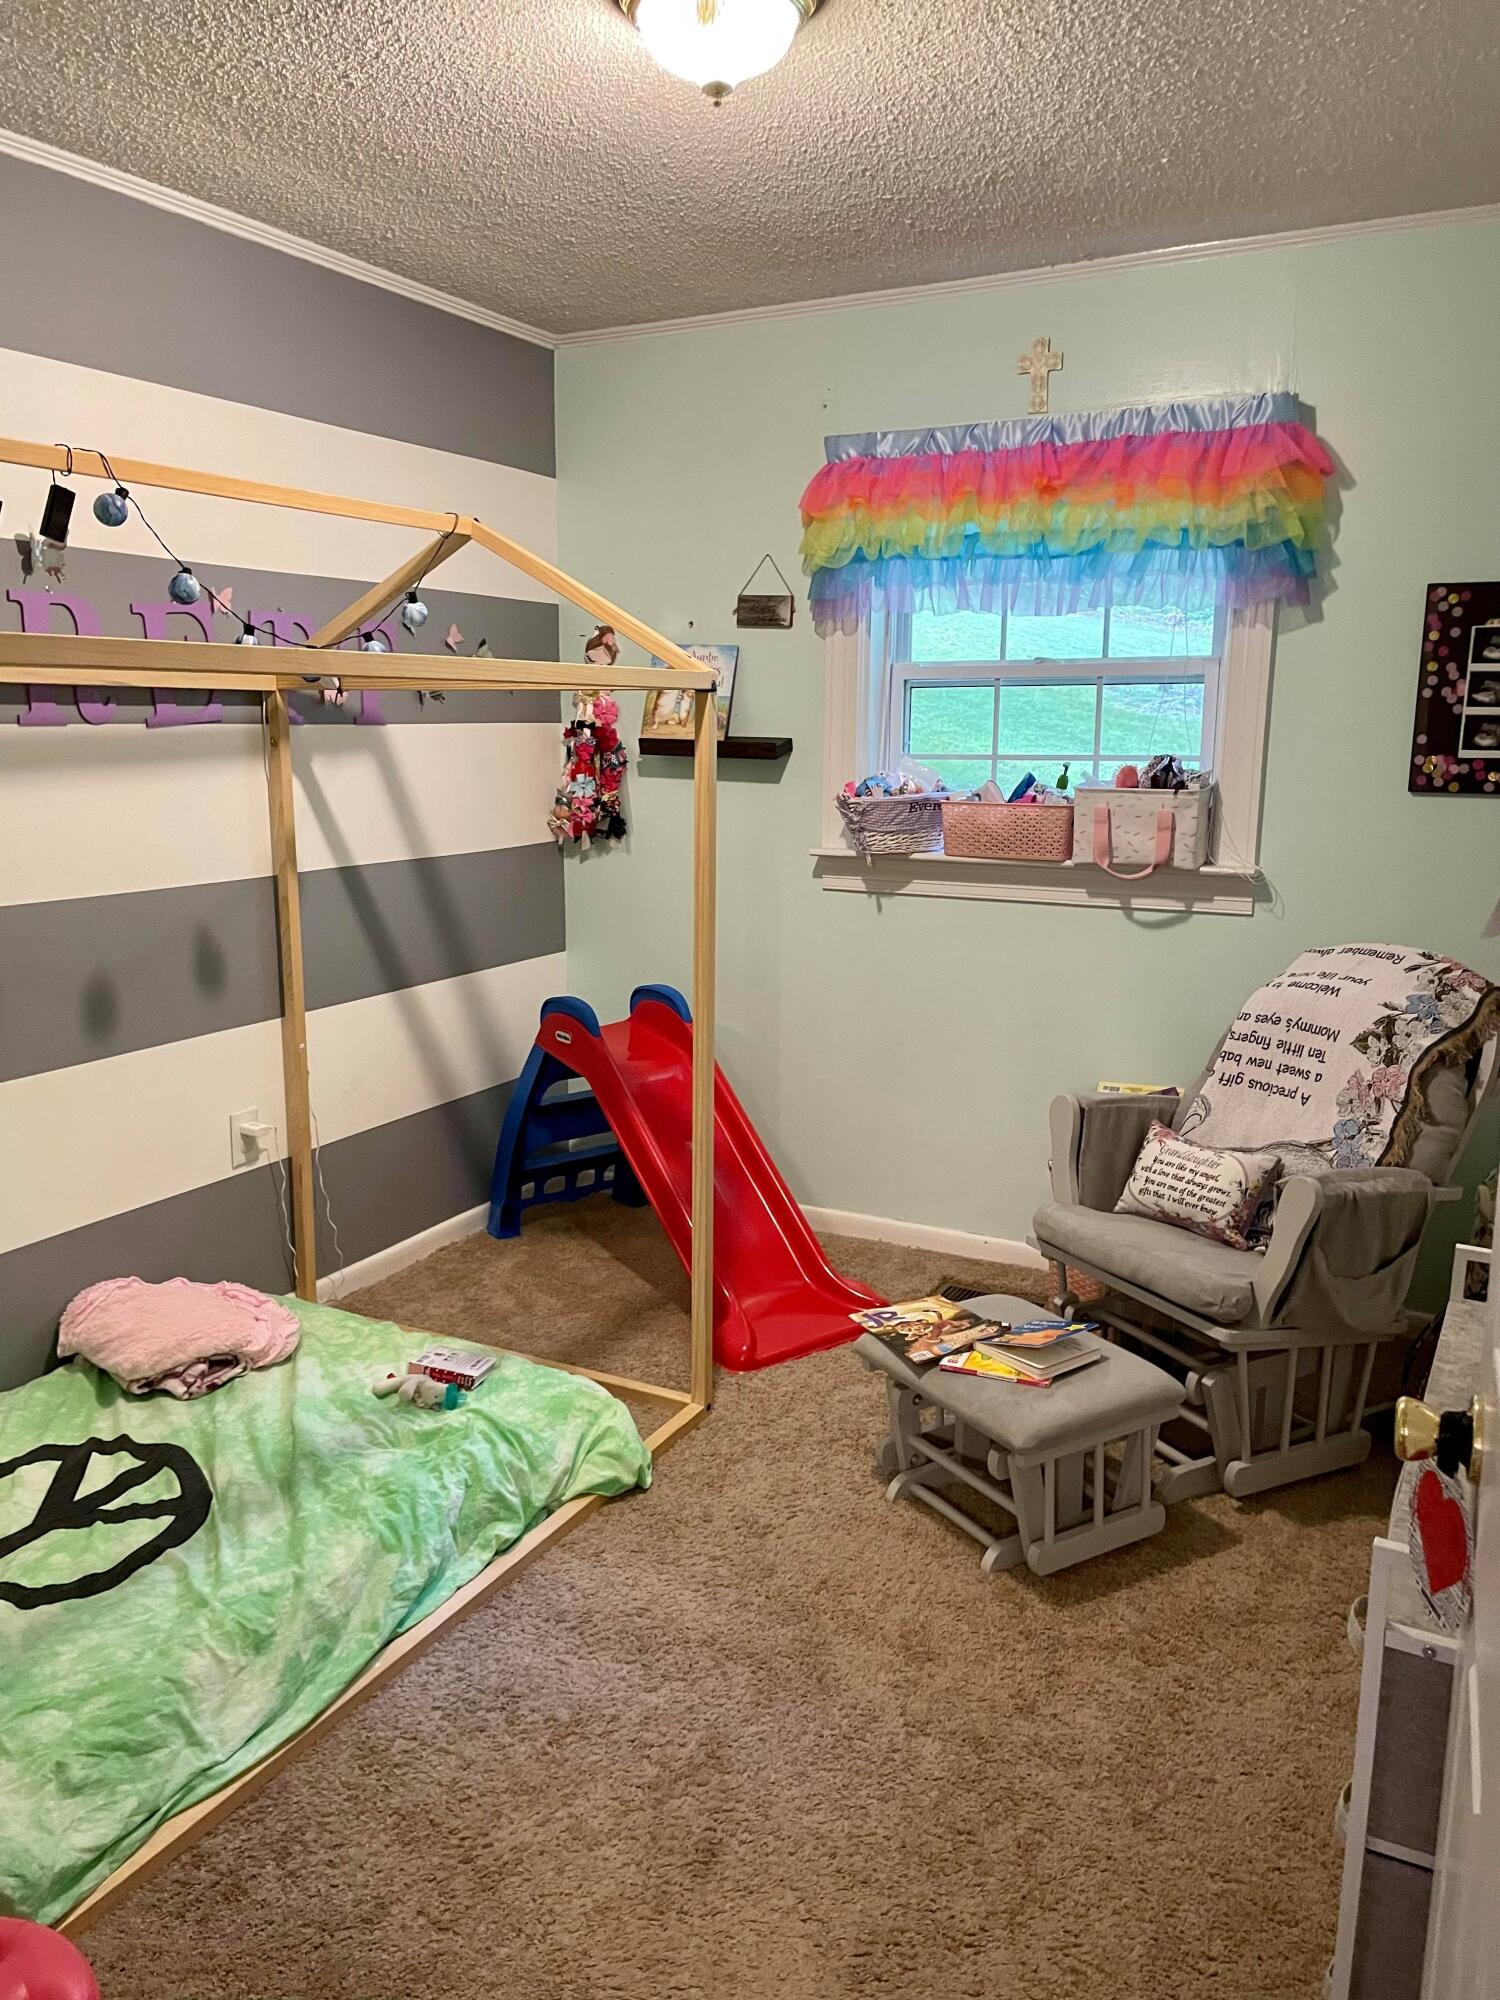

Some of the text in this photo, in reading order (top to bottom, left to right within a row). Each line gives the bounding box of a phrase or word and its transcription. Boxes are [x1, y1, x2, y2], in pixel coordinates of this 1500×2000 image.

[1337, 947, 1406, 965] Remember
[1317, 971, 1339, 980] life
[1338, 975, 1372, 986] your
[1288, 981, 1342, 997] Welcome
[1254, 1012, 1281, 1026] eyes
[1286, 1017, 1340, 1043] Mommy's
[1228, 1030, 1326, 1063] Ten little fingers
[1245, 1056, 1273, 1070] new
[1276, 1062, 1311, 1081] sweet
[1218, 1071, 1245, 1088] gift
[1315, 1073, 1323, 1083] a
[1248, 1078, 1299, 1099] precious
[1300, 1092, 1312, 1107] A
[1159, 1145, 1222, 1169] Granddaughter
[1151, 1156, 1164, 1167] You
[1175, 1162, 1187, 1172] like
[1188, 1168, 1199, 1177] my
[1140, 1165, 1152, 1173] with
[1157, 1168, 1170, 1177] love
[1171, 1173, 1186, 1182] that
[1185, 1179, 1208, 1191] always
[1138, 1187, 1152, 1196] gifts
[1152, 1190, 1166, 1200] that
[1171, 1196, 1184, 1206] will
[1184, 1200, 1199, 1210] ever
[1143, 1176, 1226, 1208] You are one of the greatest
